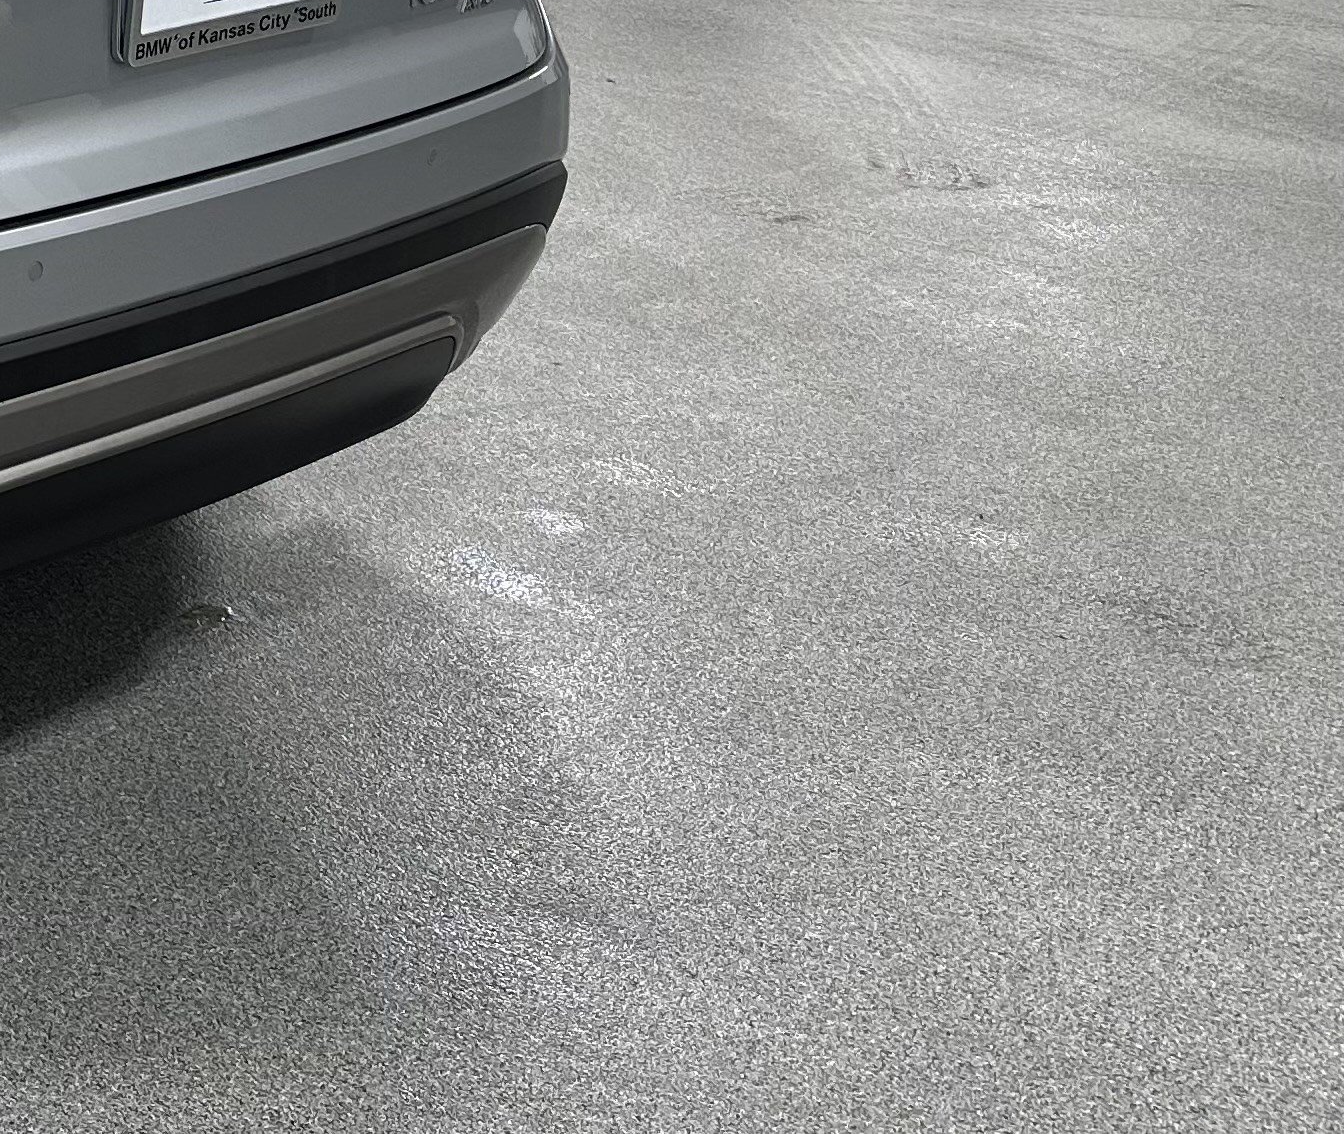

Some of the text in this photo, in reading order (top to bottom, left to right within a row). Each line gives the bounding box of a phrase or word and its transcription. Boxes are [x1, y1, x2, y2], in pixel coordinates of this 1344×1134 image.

[135, 1, 338, 61] BMW of Kansas City South
